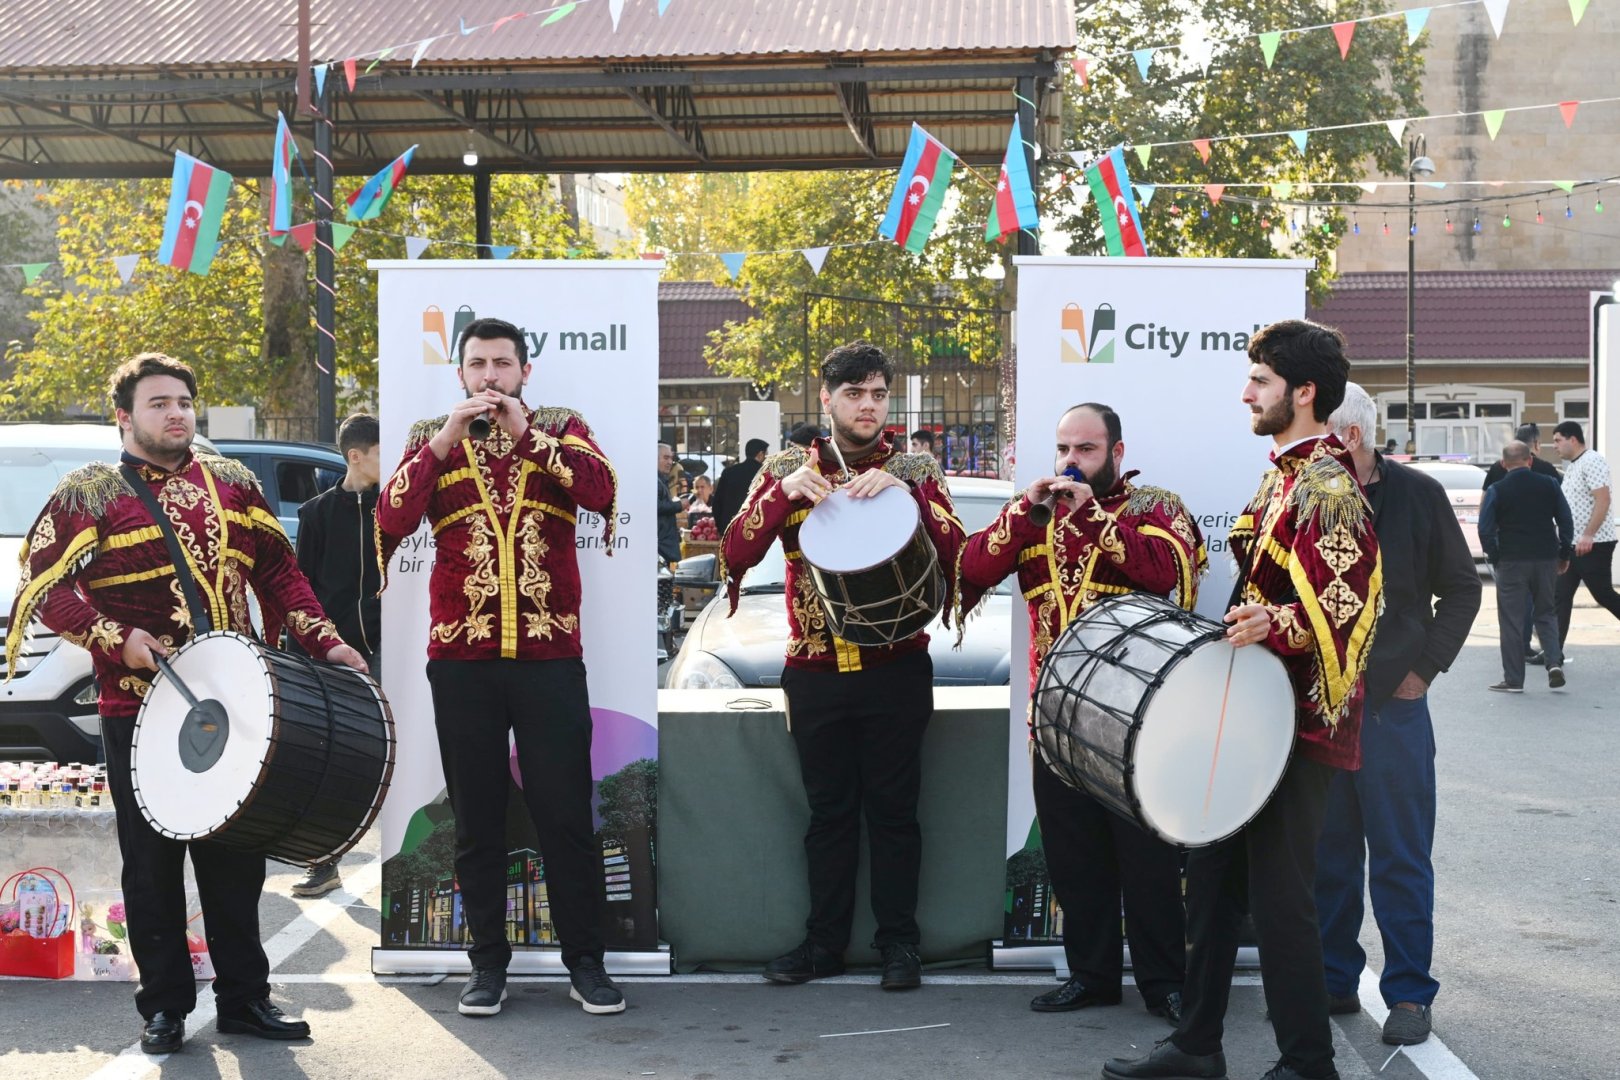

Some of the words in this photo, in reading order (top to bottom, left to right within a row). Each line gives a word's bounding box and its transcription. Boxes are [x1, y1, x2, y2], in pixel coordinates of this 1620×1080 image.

[520, 327, 548, 358] ty
[559, 324, 627, 351] mall
[1125, 323, 1190, 358] City
[1201, 323, 1268, 351] ma
[399, 556, 425, 573] bir
